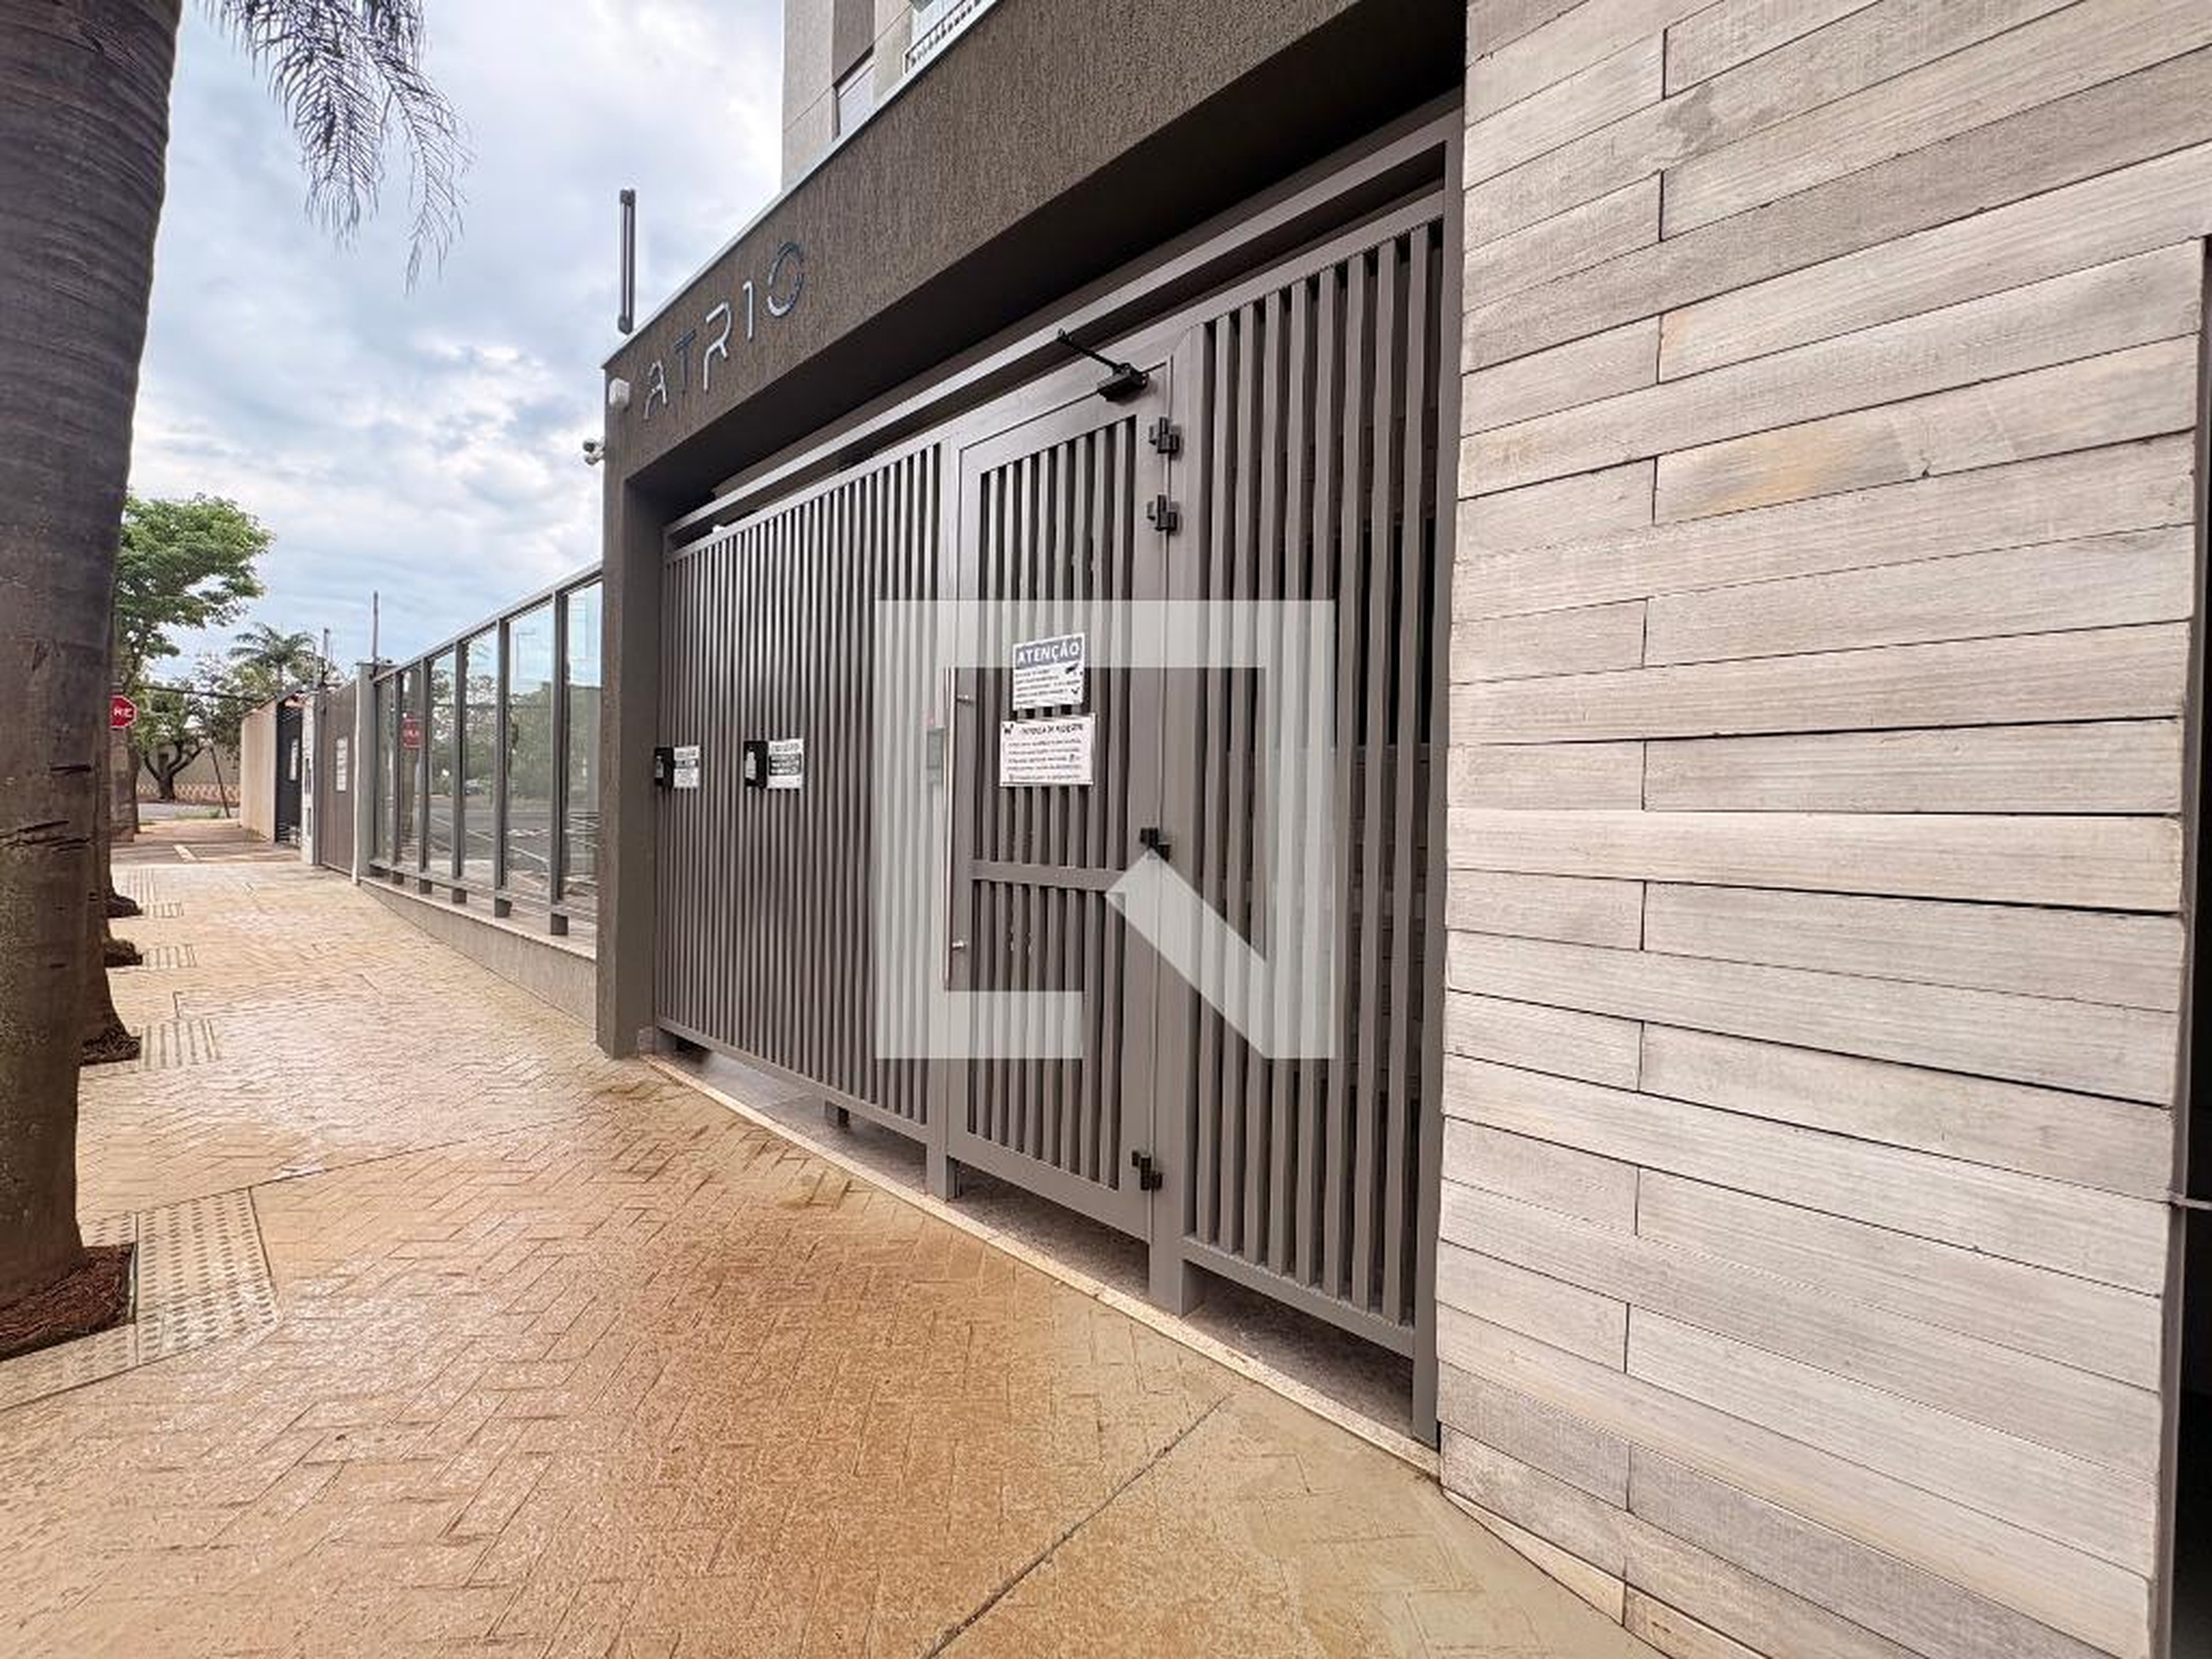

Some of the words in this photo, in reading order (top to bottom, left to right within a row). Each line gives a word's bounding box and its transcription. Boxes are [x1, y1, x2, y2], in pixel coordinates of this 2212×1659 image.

[643, 241, 804, 421] ATRIO
[1017, 641, 1080, 664] ATENÇÃO
[113, 707, 132, 718] RE
